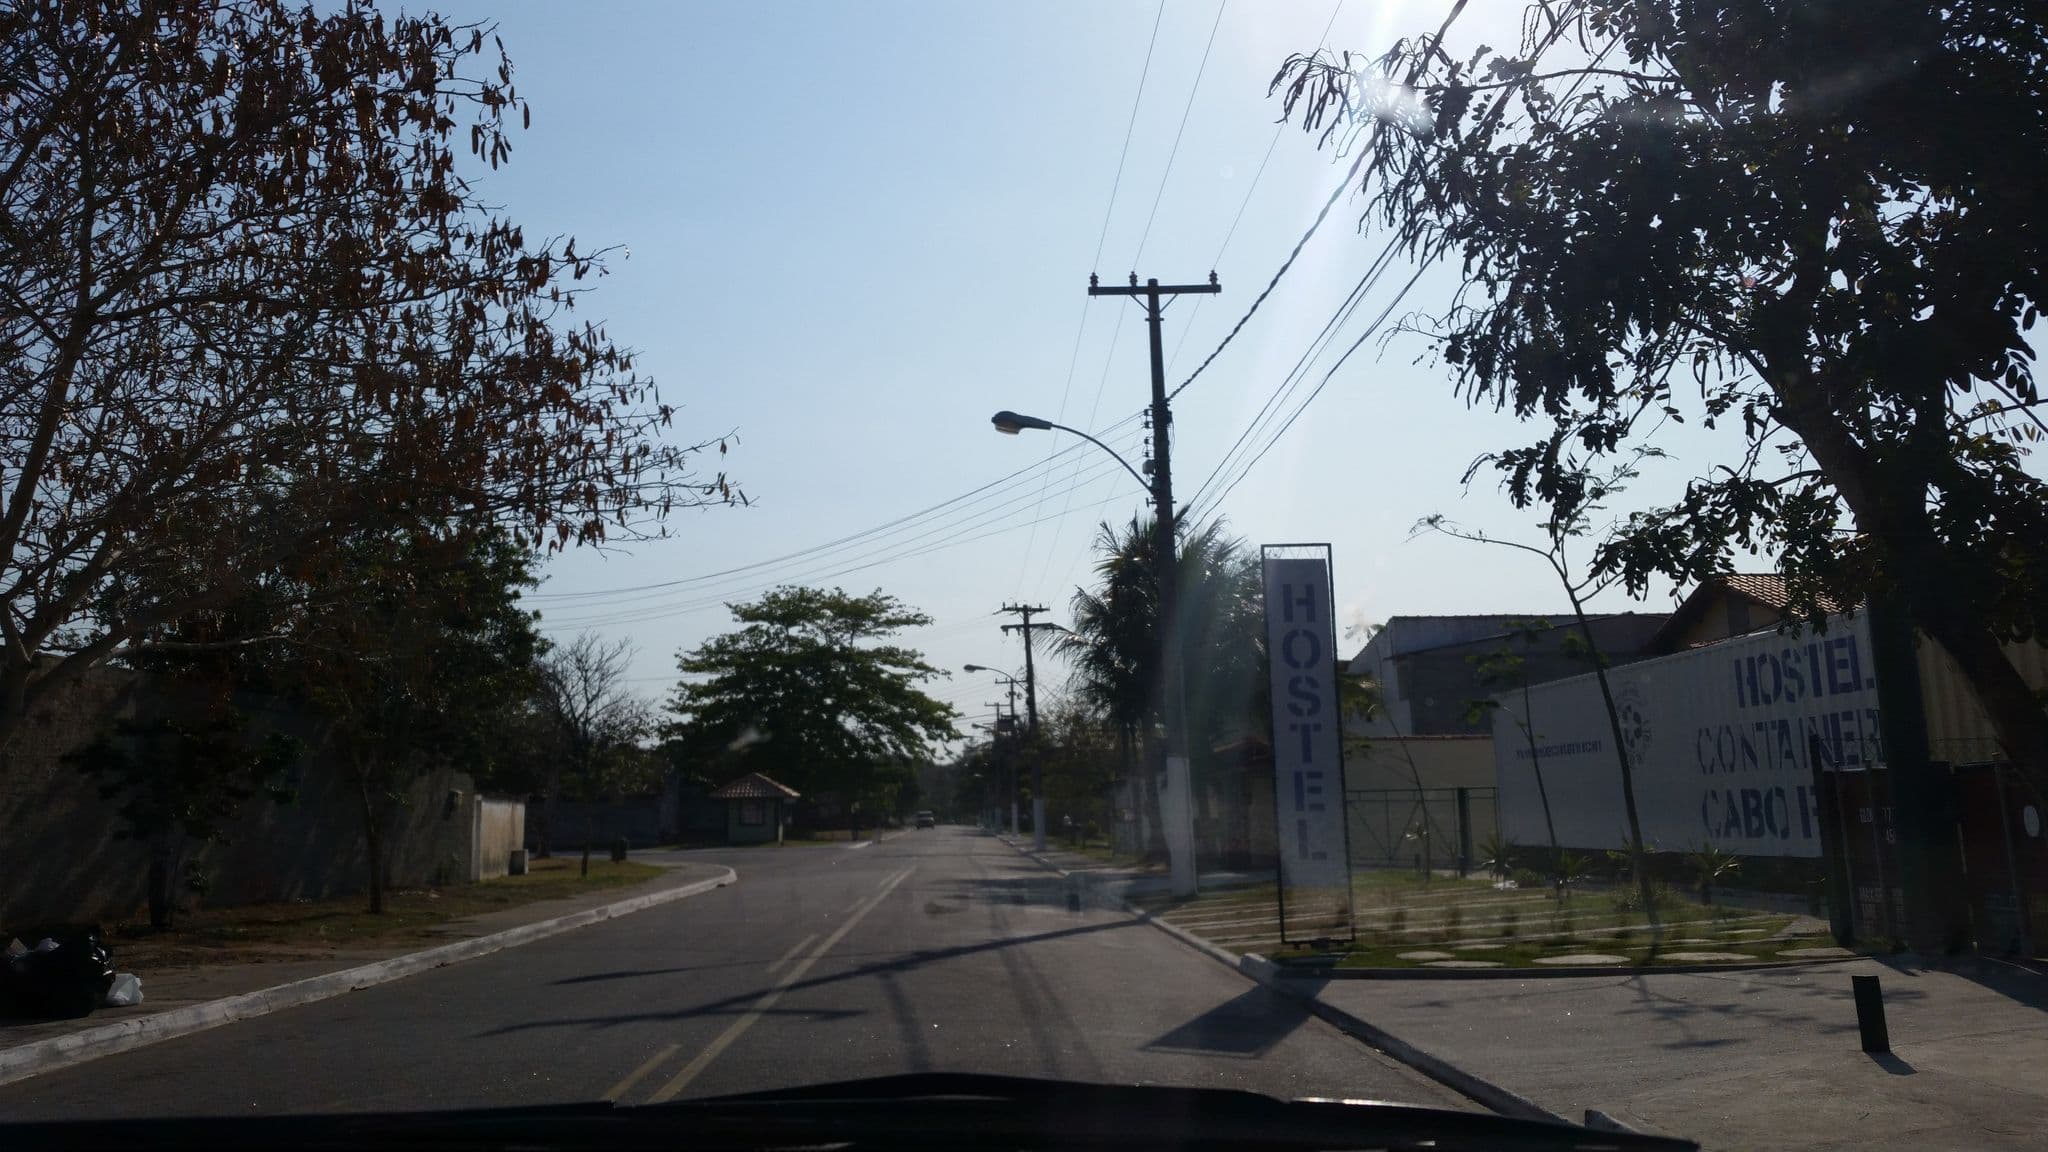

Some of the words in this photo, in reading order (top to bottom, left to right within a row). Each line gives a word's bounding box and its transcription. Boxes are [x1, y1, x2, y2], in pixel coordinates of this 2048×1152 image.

[1734, 634, 1875, 708] HOSTEL
[1282, 583, 1327, 860] HOSTEL
[1697, 708, 1887, 775] CONTAINER
[1702, 786, 1792, 840] CABO
